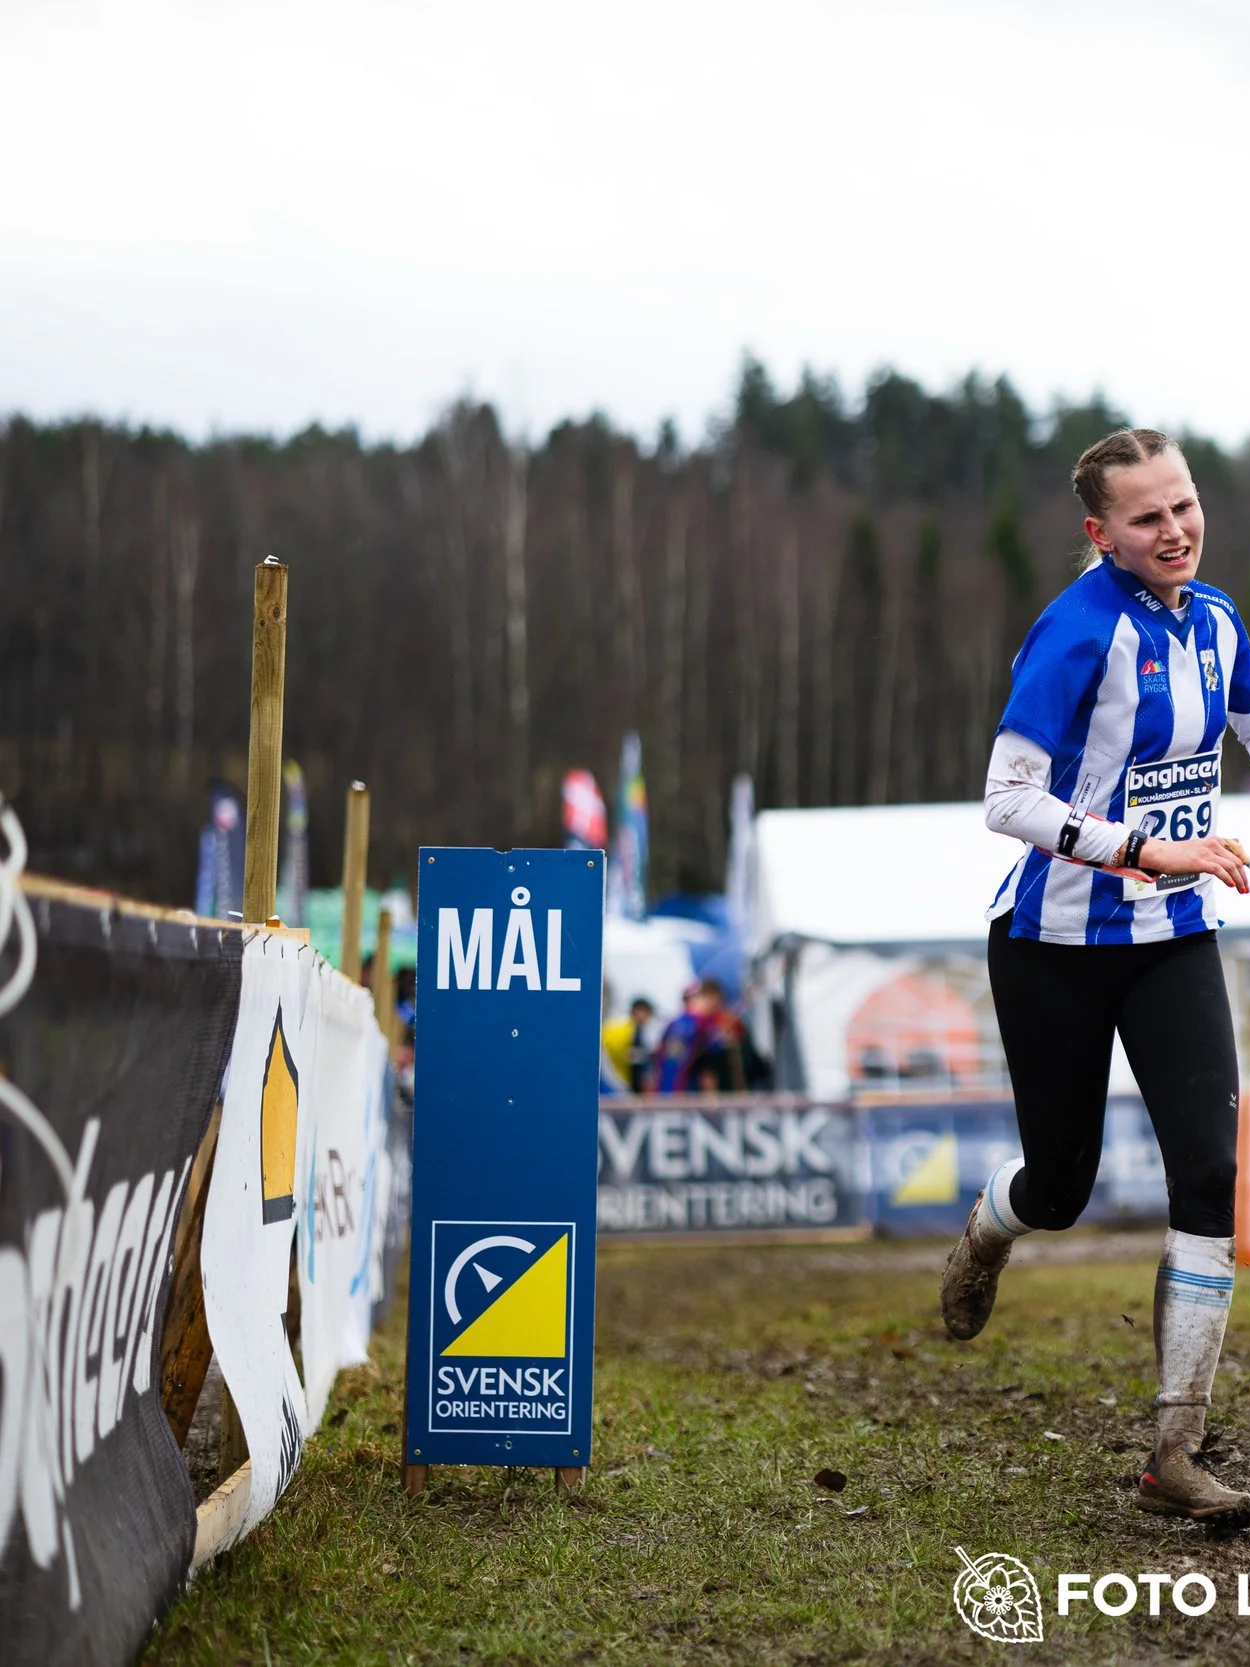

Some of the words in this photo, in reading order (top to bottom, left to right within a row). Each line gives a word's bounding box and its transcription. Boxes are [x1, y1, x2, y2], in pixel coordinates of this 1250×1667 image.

[1145, 800, 1212, 842] 269
[437, 886, 581, 991] MÅL
[596, 1107, 834, 1181] VENSK
[596, 1178, 837, 1228] RIENTERING
[437, 1366, 566, 1397] SVENSK
[436, 1400, 566, 1420] ORIENTERING
